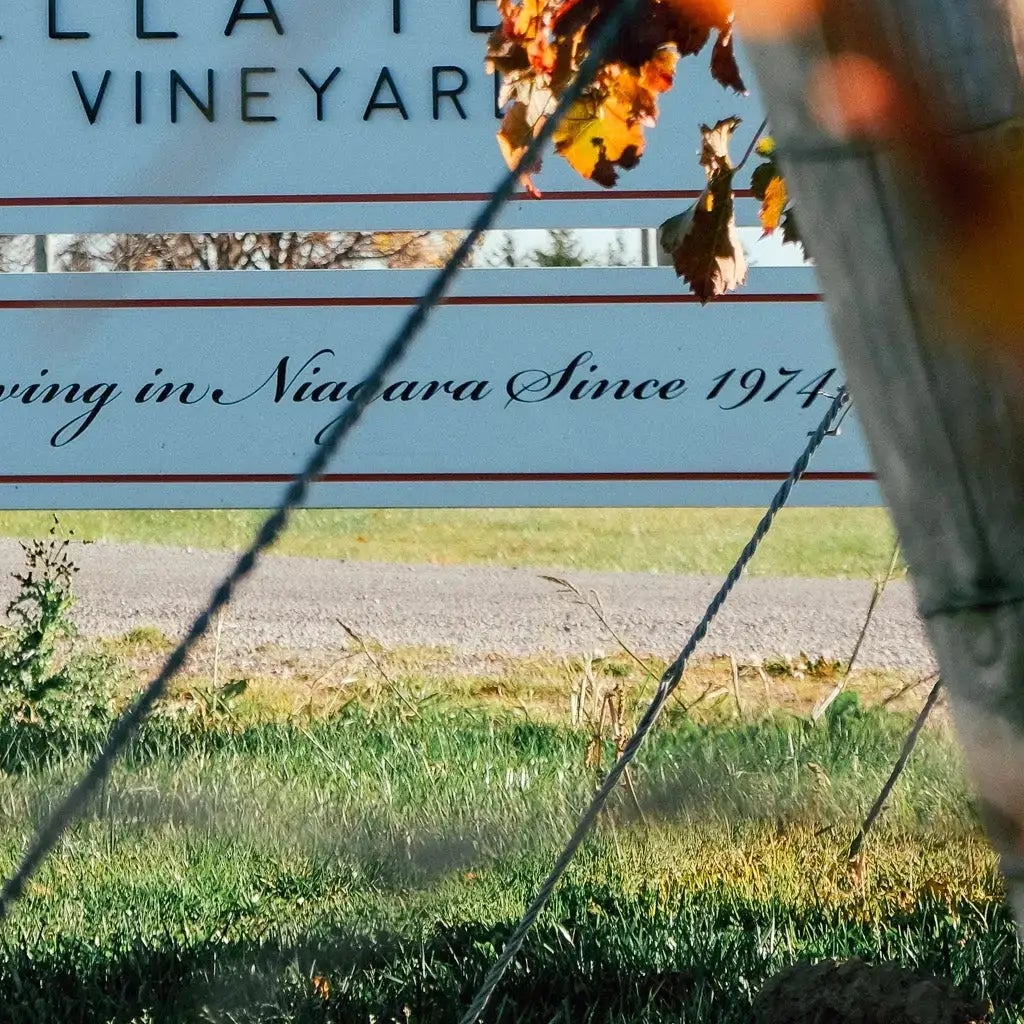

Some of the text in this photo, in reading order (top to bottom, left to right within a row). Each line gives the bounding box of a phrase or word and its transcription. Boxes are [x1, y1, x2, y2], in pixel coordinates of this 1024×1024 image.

[72, 66, 506, 125] VINEYAR
[134, 367, 211, 405] in
[505, 350, 688, 410] Since
[706, 367, 837, 410] 1974
